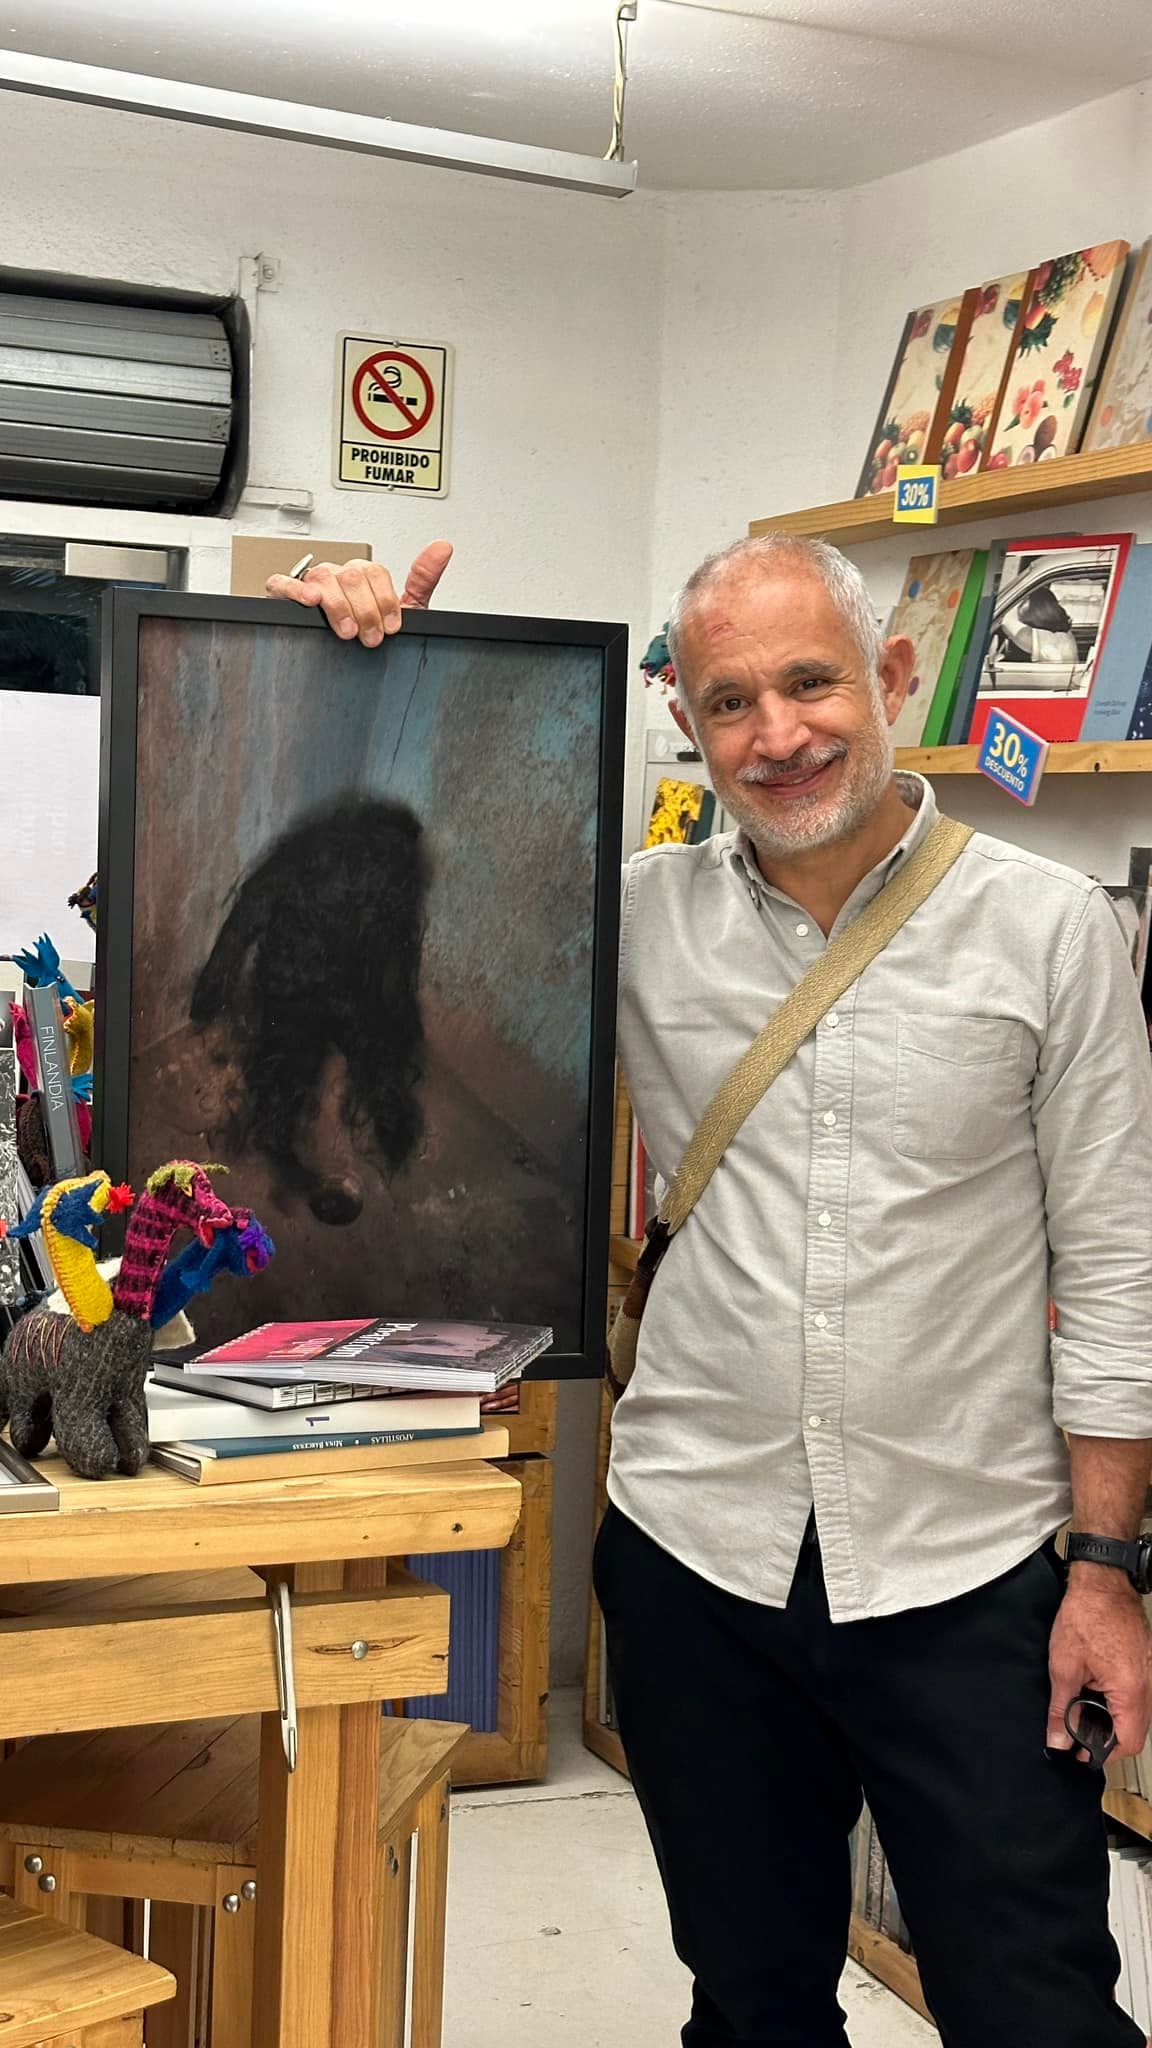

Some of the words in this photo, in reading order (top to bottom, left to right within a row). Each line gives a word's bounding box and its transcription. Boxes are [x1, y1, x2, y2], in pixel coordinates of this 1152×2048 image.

[351, 447, 429, 468] PROHIBIDO
[365, 465, 415, 483] FUMAR
[901, 483, 929, 506] 30%
[989, 722, 1029, 778] 30%
[984, 756, 1025, 792] DESCUENTO
[40, 1026, 65, 1111] FINLANDIA
[371, 1433, 415, 1444] APOSTILLAS
